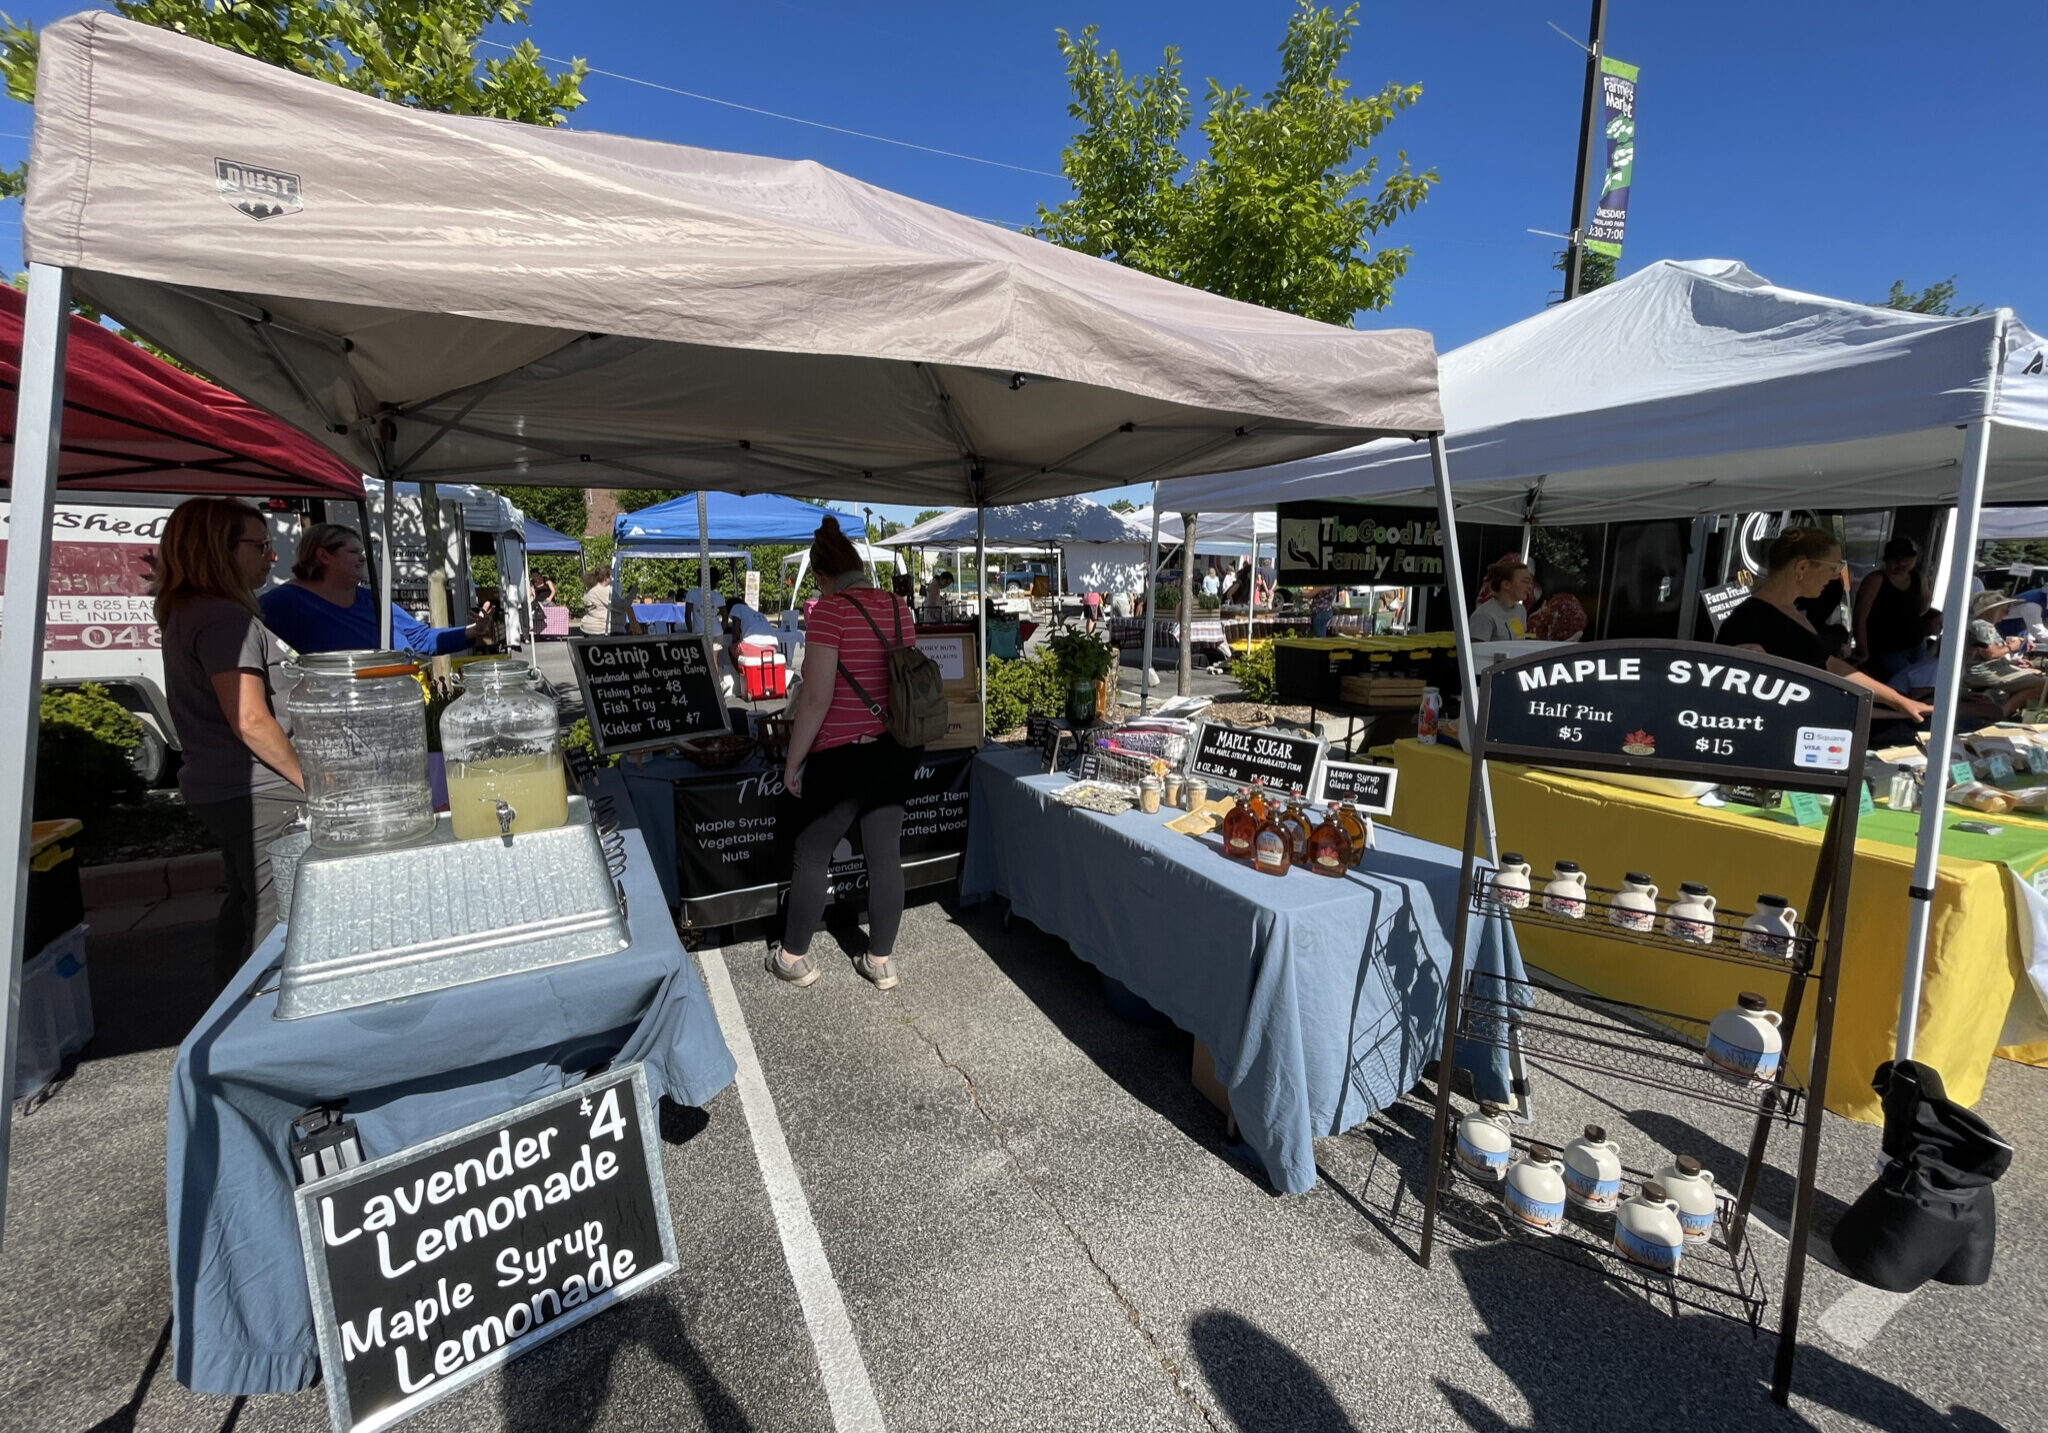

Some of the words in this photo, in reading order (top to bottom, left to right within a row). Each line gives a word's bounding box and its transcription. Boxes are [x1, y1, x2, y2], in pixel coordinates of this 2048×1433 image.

[225, 167, 289, 195] QUEST
[53, 511, 169, 538] Shed
[1322, 546, 1390, 579] Family
[1393, 549, 1443, 574] Farm
[50, 600, 71, 610] TH
[77, 600, 87, 610] &
[93, 600, 122, 610] 625
[127, 600, 156, 611] EAS
[1704, 591, 1728, 605] Farm
[46, 611, 79, 622] LE,
[88, 611, 156, 622] INDIAN
[588, 644, 649, 669] Catnip
[656, 642, 700, 665] Toys
[587, 671, 630, 685] Handmade
[633, 668, 650, 679] with
[652, 666, 681, 680] Organic
[684, 664, 707, 675] Catnip
[1518, 658, 1641, 692] MAPLE
[1667, 660, 1811, 707] SYRUP
[597, 688, 630, 699] Fishing
[633, 685, 652, 695] Pole
[666, 679, 682, 693] $8
[602, 701, 629, 715] Fish
[632, 698, 656, 713] Toy
[671, 694, 688, 707] $4
[1528, 701, 1569, 719] Half
[1574, 704, 1614, 723] Pint
[1678, 710, 1764, 732] Quart
[601, 720, 642, 737] Kicker
[647, 717, 671, 731] Toy
[686, 712, 701, 725] $7
[1216, 730, 1252, 751] MAPLE
[1254, 738, 1293, 760] SUGAR
[1559, 725, 1583, 743] $5
[1695, 737, 1734, 756] $15
[1202, 763, 1212, 772] OZ
[1228, 767, 1238, 778] $8
[1270, 776, 1283, 788] BAG
[1290, 780, 1303, 792] $10
[1287, 762, 1302, 773] FORM
[1330, 769, 1353, 780] Maple
[1357, 771, 1380, 784] Syrup
[736, 770, 786, 804] The
[1329, 779, 1350, 790] Glass
[1353, 784, 1379, 795] Bottle
[695, 819, 736, 834] Maple
[738, 815, 777, 829] Syrup
[939, 805, 964, 819] Toys
[939, 818, 968, 832] Wood
[699, 831, 774, 849] Vegetables
[722, 850, 750, 863] Nuts
[322, 1129, 558, 1247] Lavender
[579, 1087, 627, 1144] $4
[376, 1143, 620, 1279] Lemonade
[340, 1278, 475, 1363] Maple
[496, 1220, 604, 1288] Syrup
[395, 1243, 638, 1395] Lemonade
